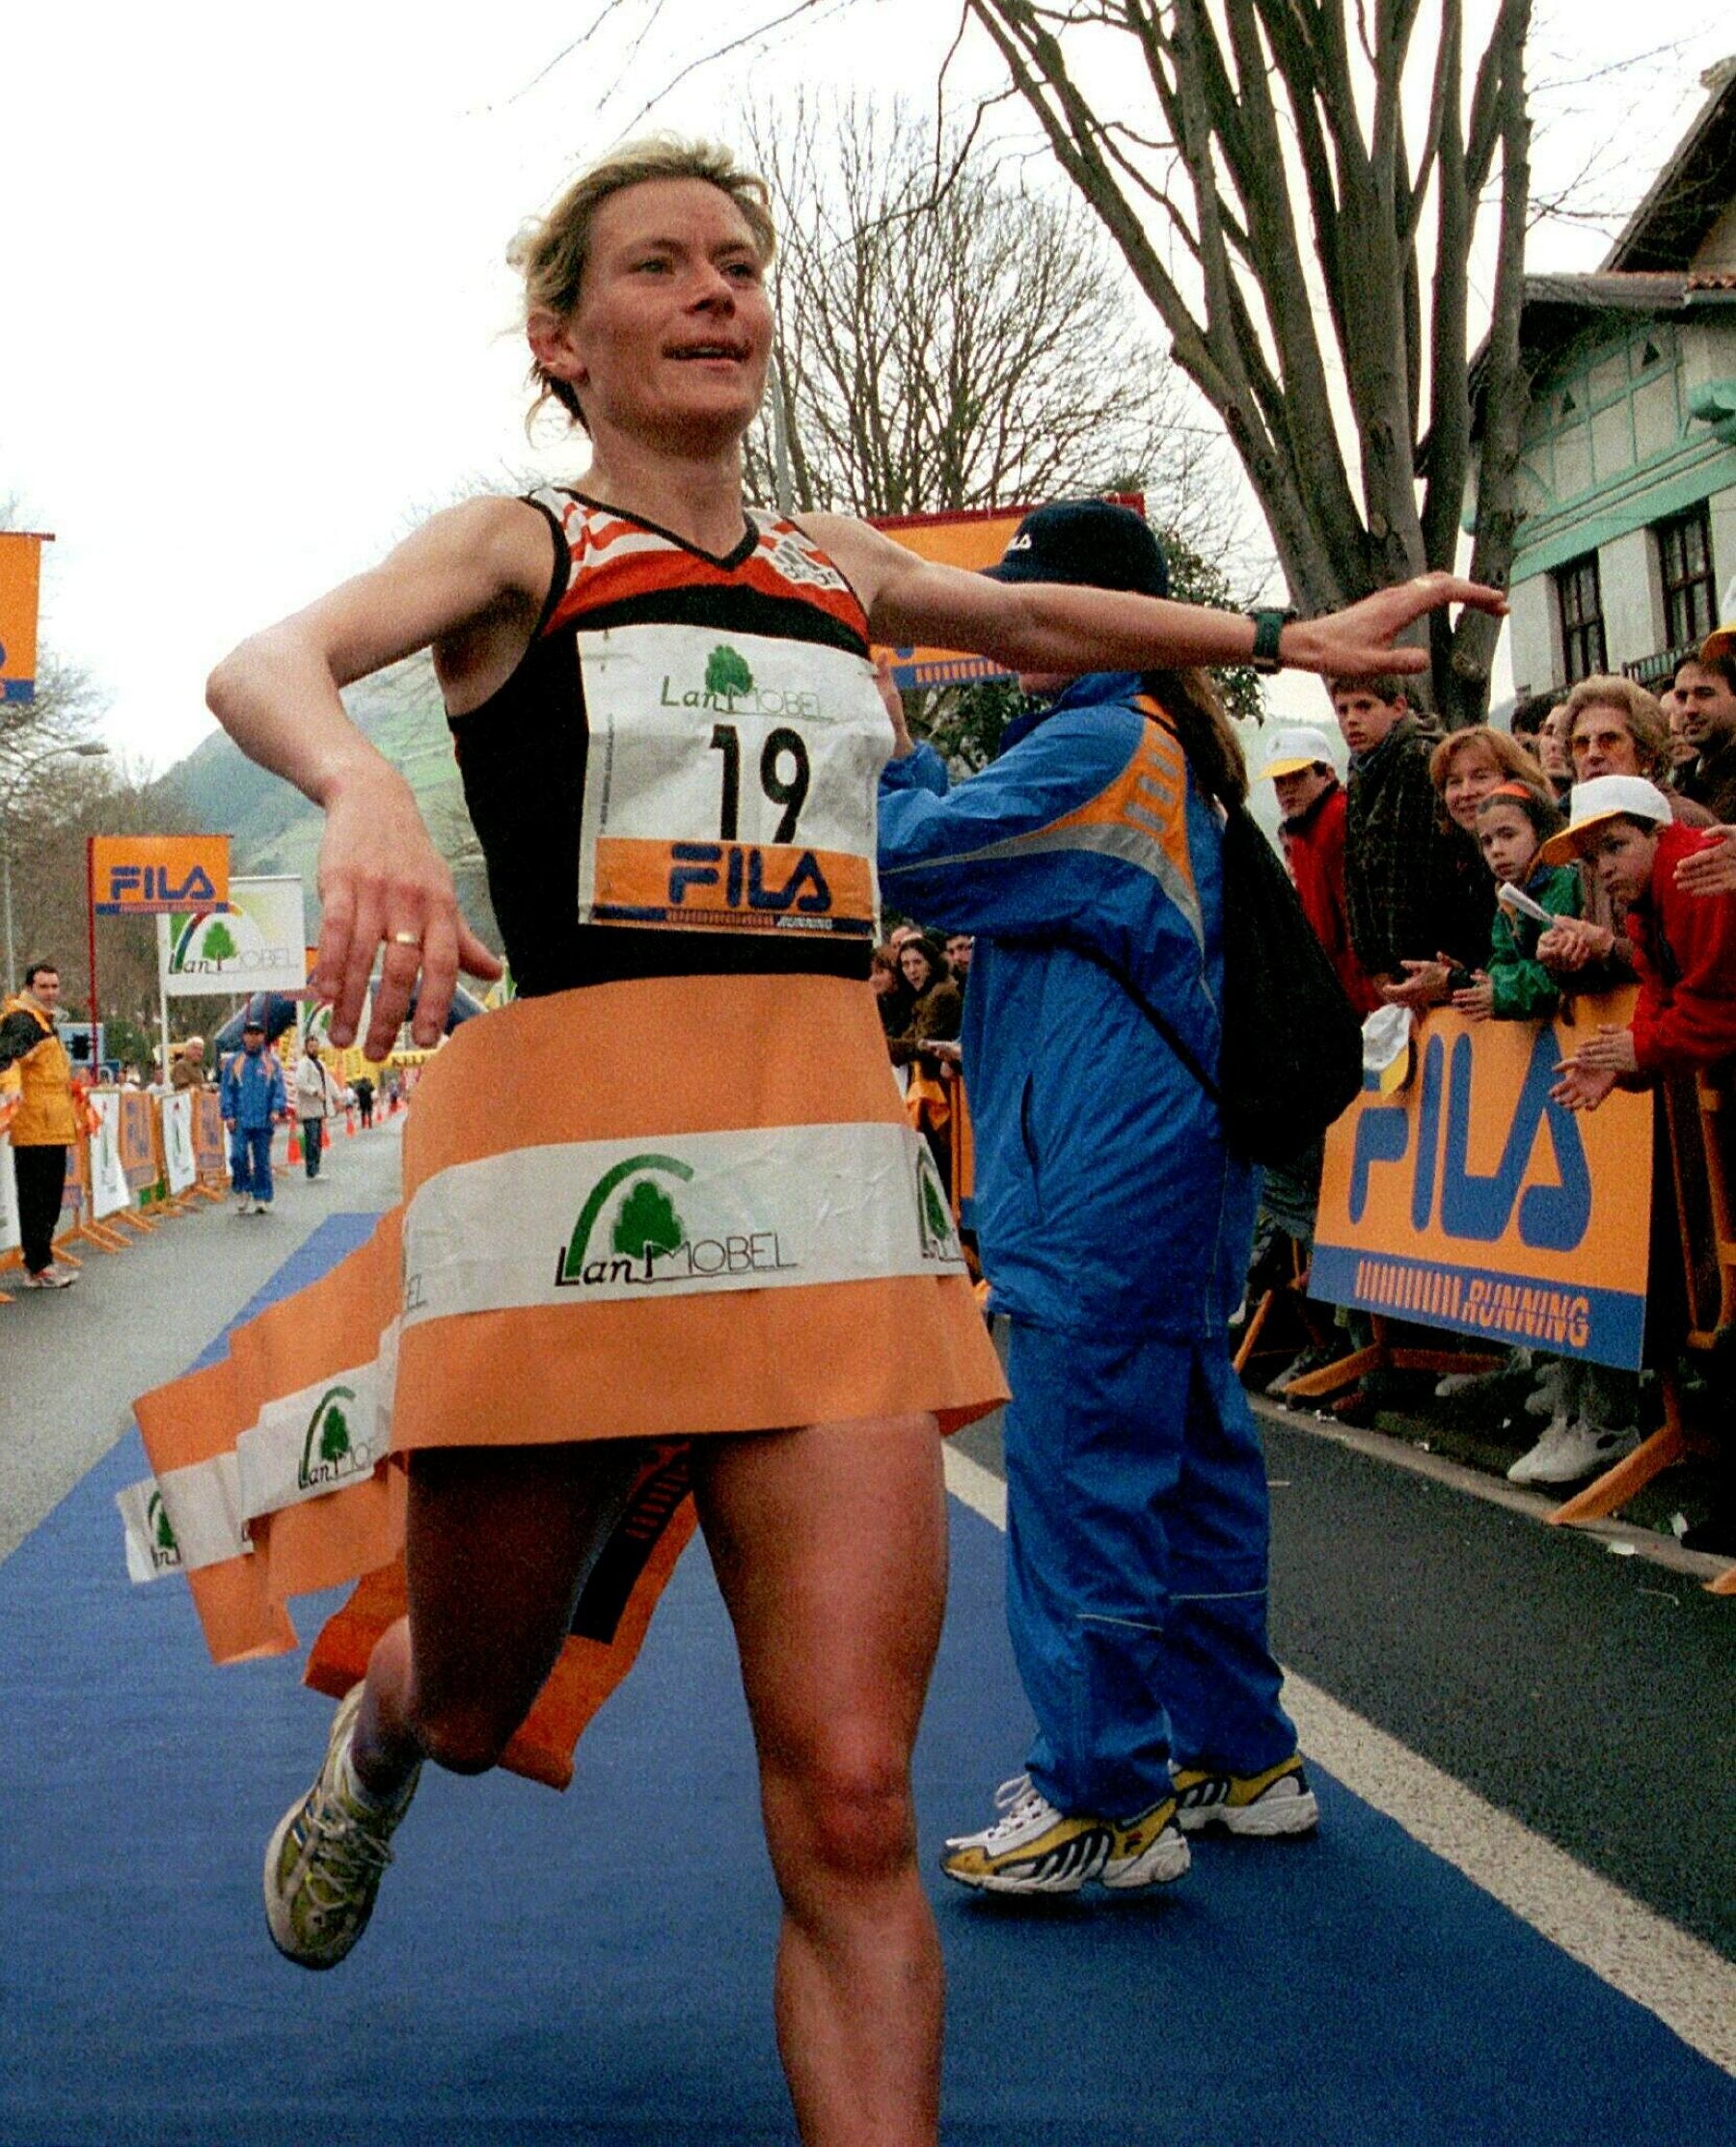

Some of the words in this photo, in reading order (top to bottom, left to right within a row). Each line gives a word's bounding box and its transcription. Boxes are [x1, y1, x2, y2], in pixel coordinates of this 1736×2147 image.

[710, 723, 810, 845] 19
[110, 865, 216, 900] FILA
[668, 841, 832, 912] FILA
[1347, 1024, 1592, 1253] FILA
[1461, 1279, 1590, 1349] RUNNING
